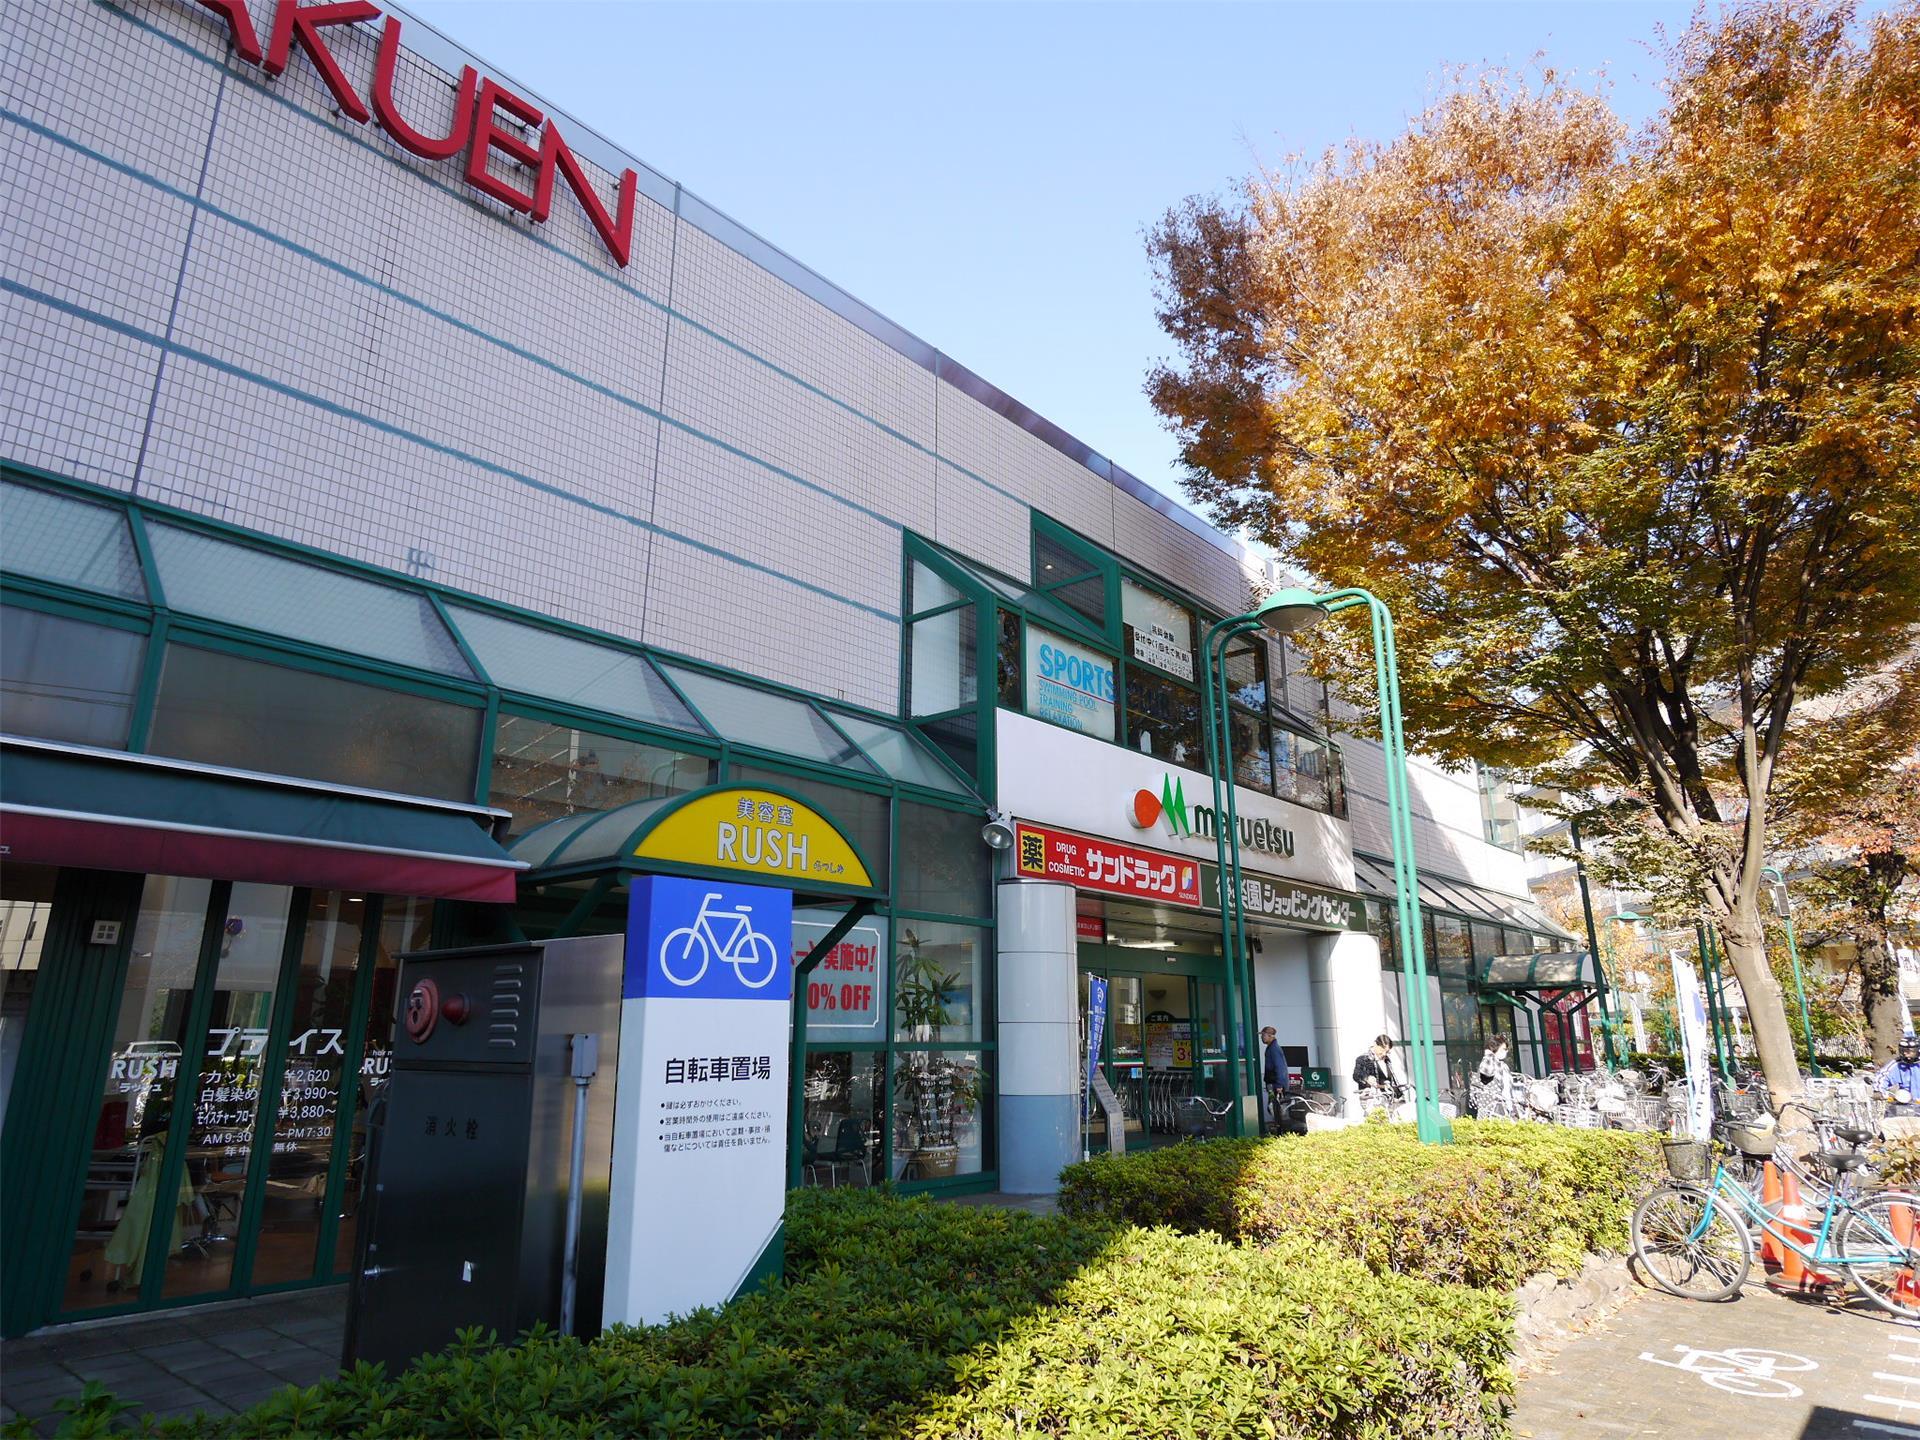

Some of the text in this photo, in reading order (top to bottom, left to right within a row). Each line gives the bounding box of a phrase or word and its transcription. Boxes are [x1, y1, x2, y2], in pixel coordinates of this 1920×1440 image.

[1039, 643, 1116, 701] SPORTS
[1039, 694, 1073, 713] TRAINING
[736, 797, 794, 827] 美容室
[717, 820, 808, 872] RUSH
[1022, 835, 1044, 870] 薬
[1056, 842, 1077, 855] DRUG
[1048, 861, 1086, 878] COSMETIC
[1064, 854, 1071, 864] &
[1086, 848, 1176, 894] サンドラッグ
[840, 984, 872, 1011] OFF
[111, 1059, 178, 1079] RUSH
[205, 1069, 330, 1084] カット ¥2,620
[665, 1056, 771, 1085] 自転車置場
[201, 1087, 259, 1103] 白髪染め
